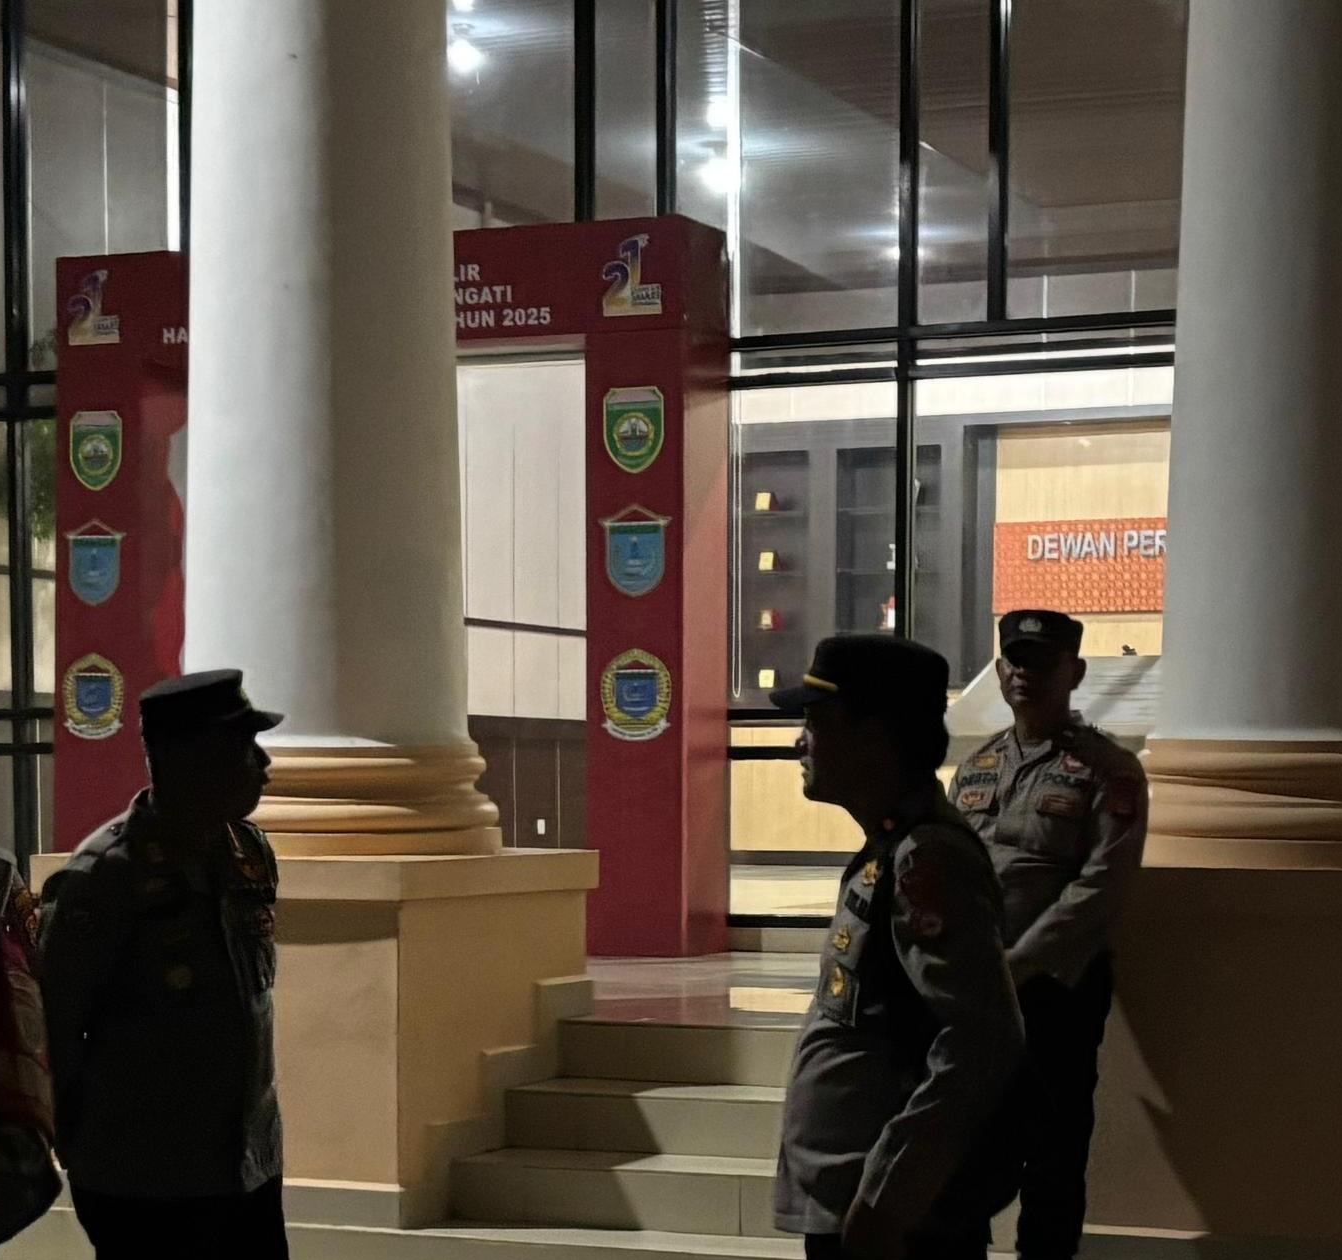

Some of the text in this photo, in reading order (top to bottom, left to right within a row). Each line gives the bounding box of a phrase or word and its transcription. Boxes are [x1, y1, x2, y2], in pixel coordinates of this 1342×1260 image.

[501, 306, 552, 327] 2025
[1026, 529, 1167, 561] DEWAN PER
